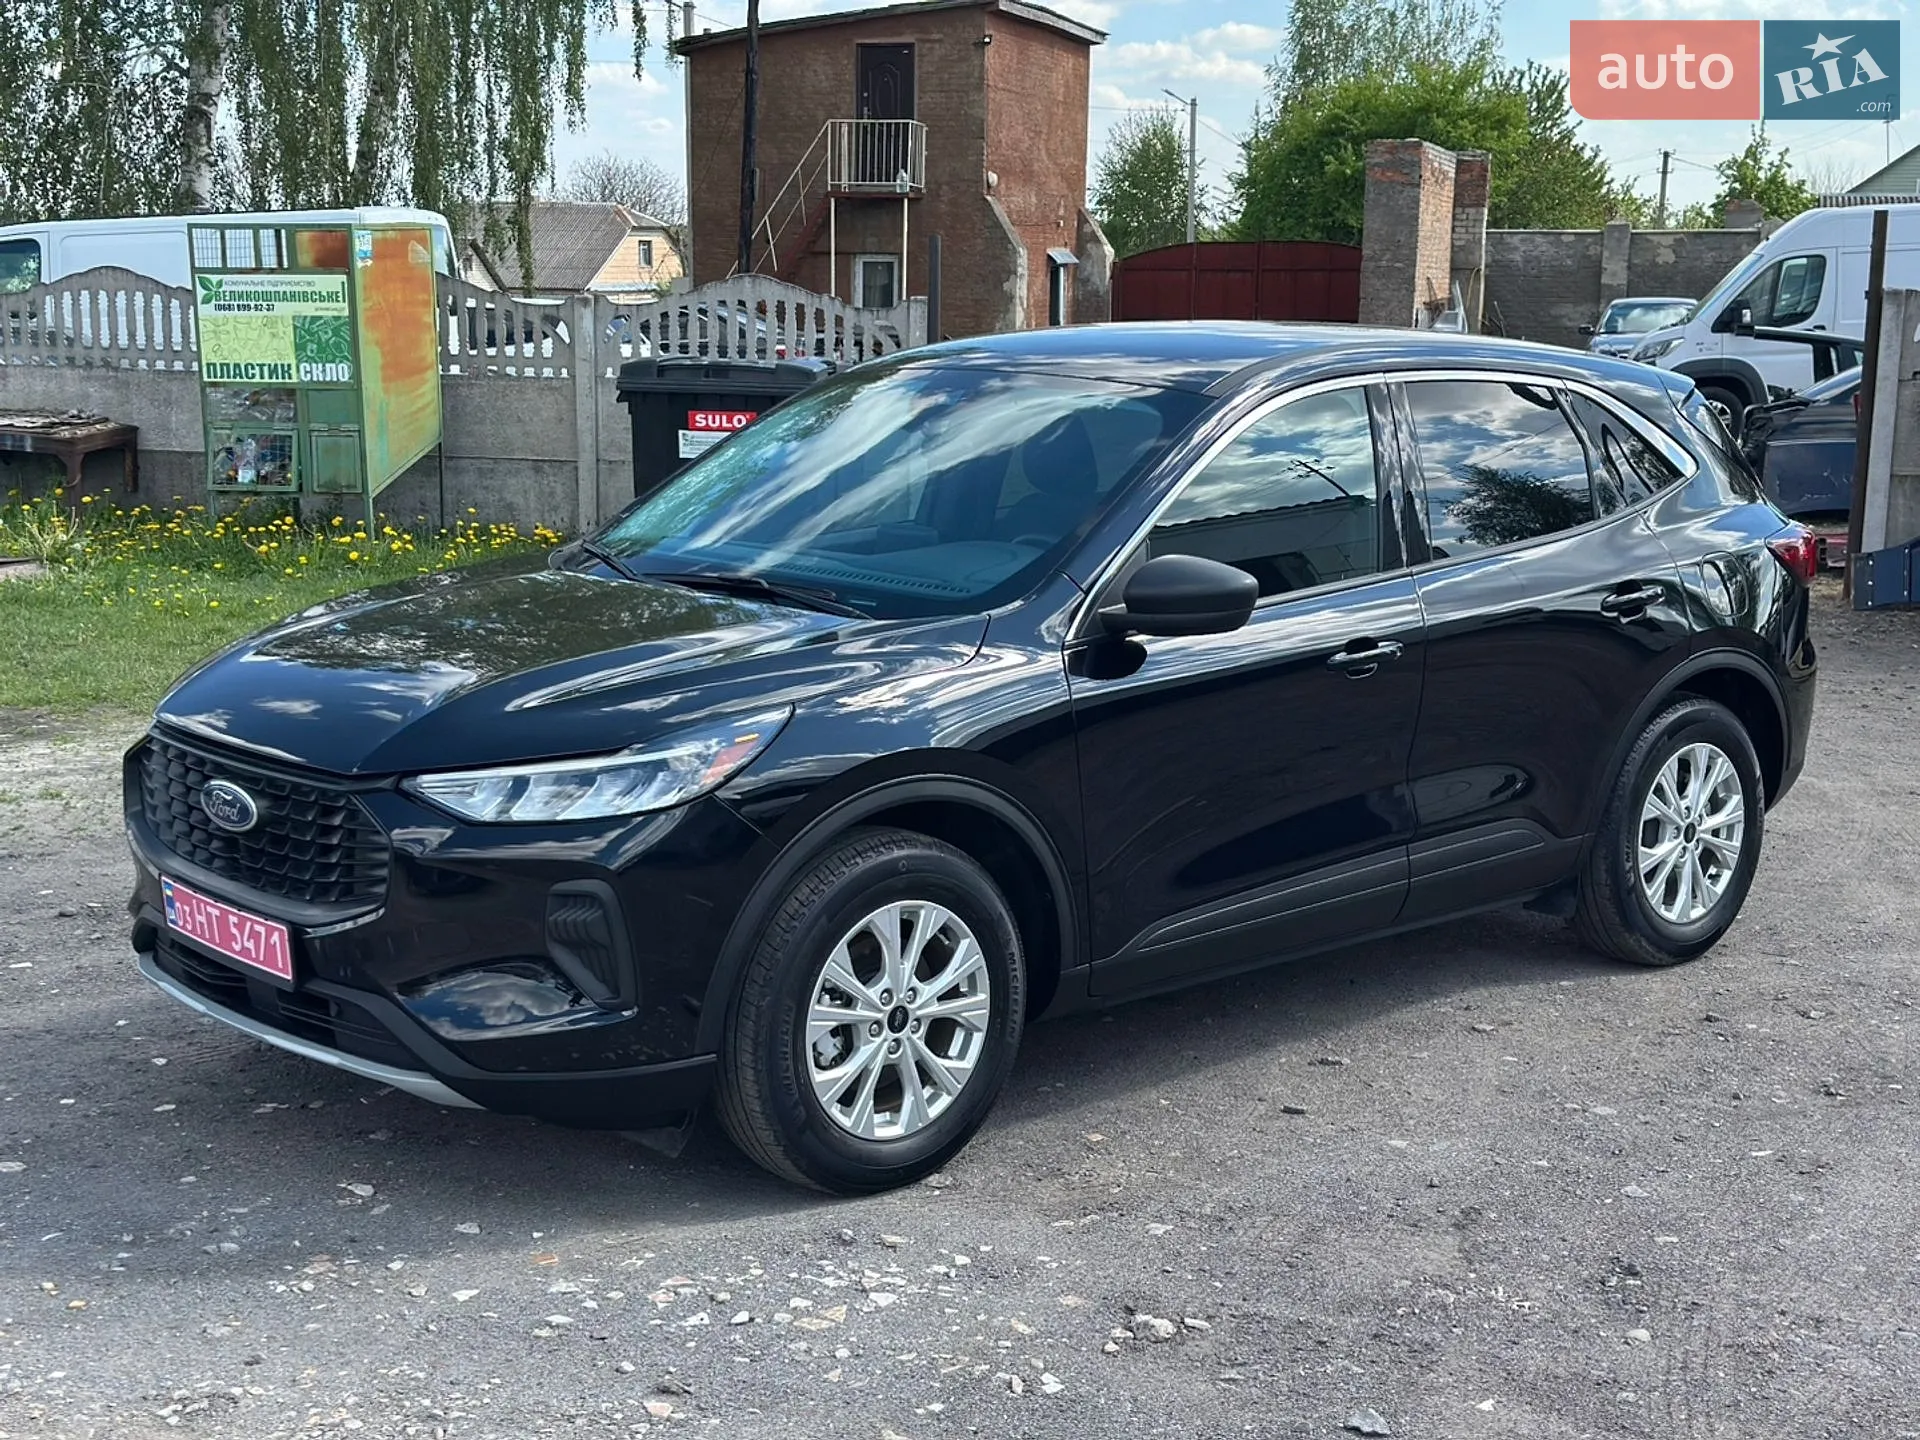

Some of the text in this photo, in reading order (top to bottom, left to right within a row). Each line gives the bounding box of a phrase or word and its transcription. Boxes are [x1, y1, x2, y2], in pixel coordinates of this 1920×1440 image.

[214, 290, 341, 303] ВЕЛИКОШПАНІВСЬКЕ
[206, 362, 350, 382] ПЛАСТИК СКЛО
[695, 413, 746, 428] SULO
[210, 790, 240, 821] Ford
[229, 916, 283, 970] 5471
